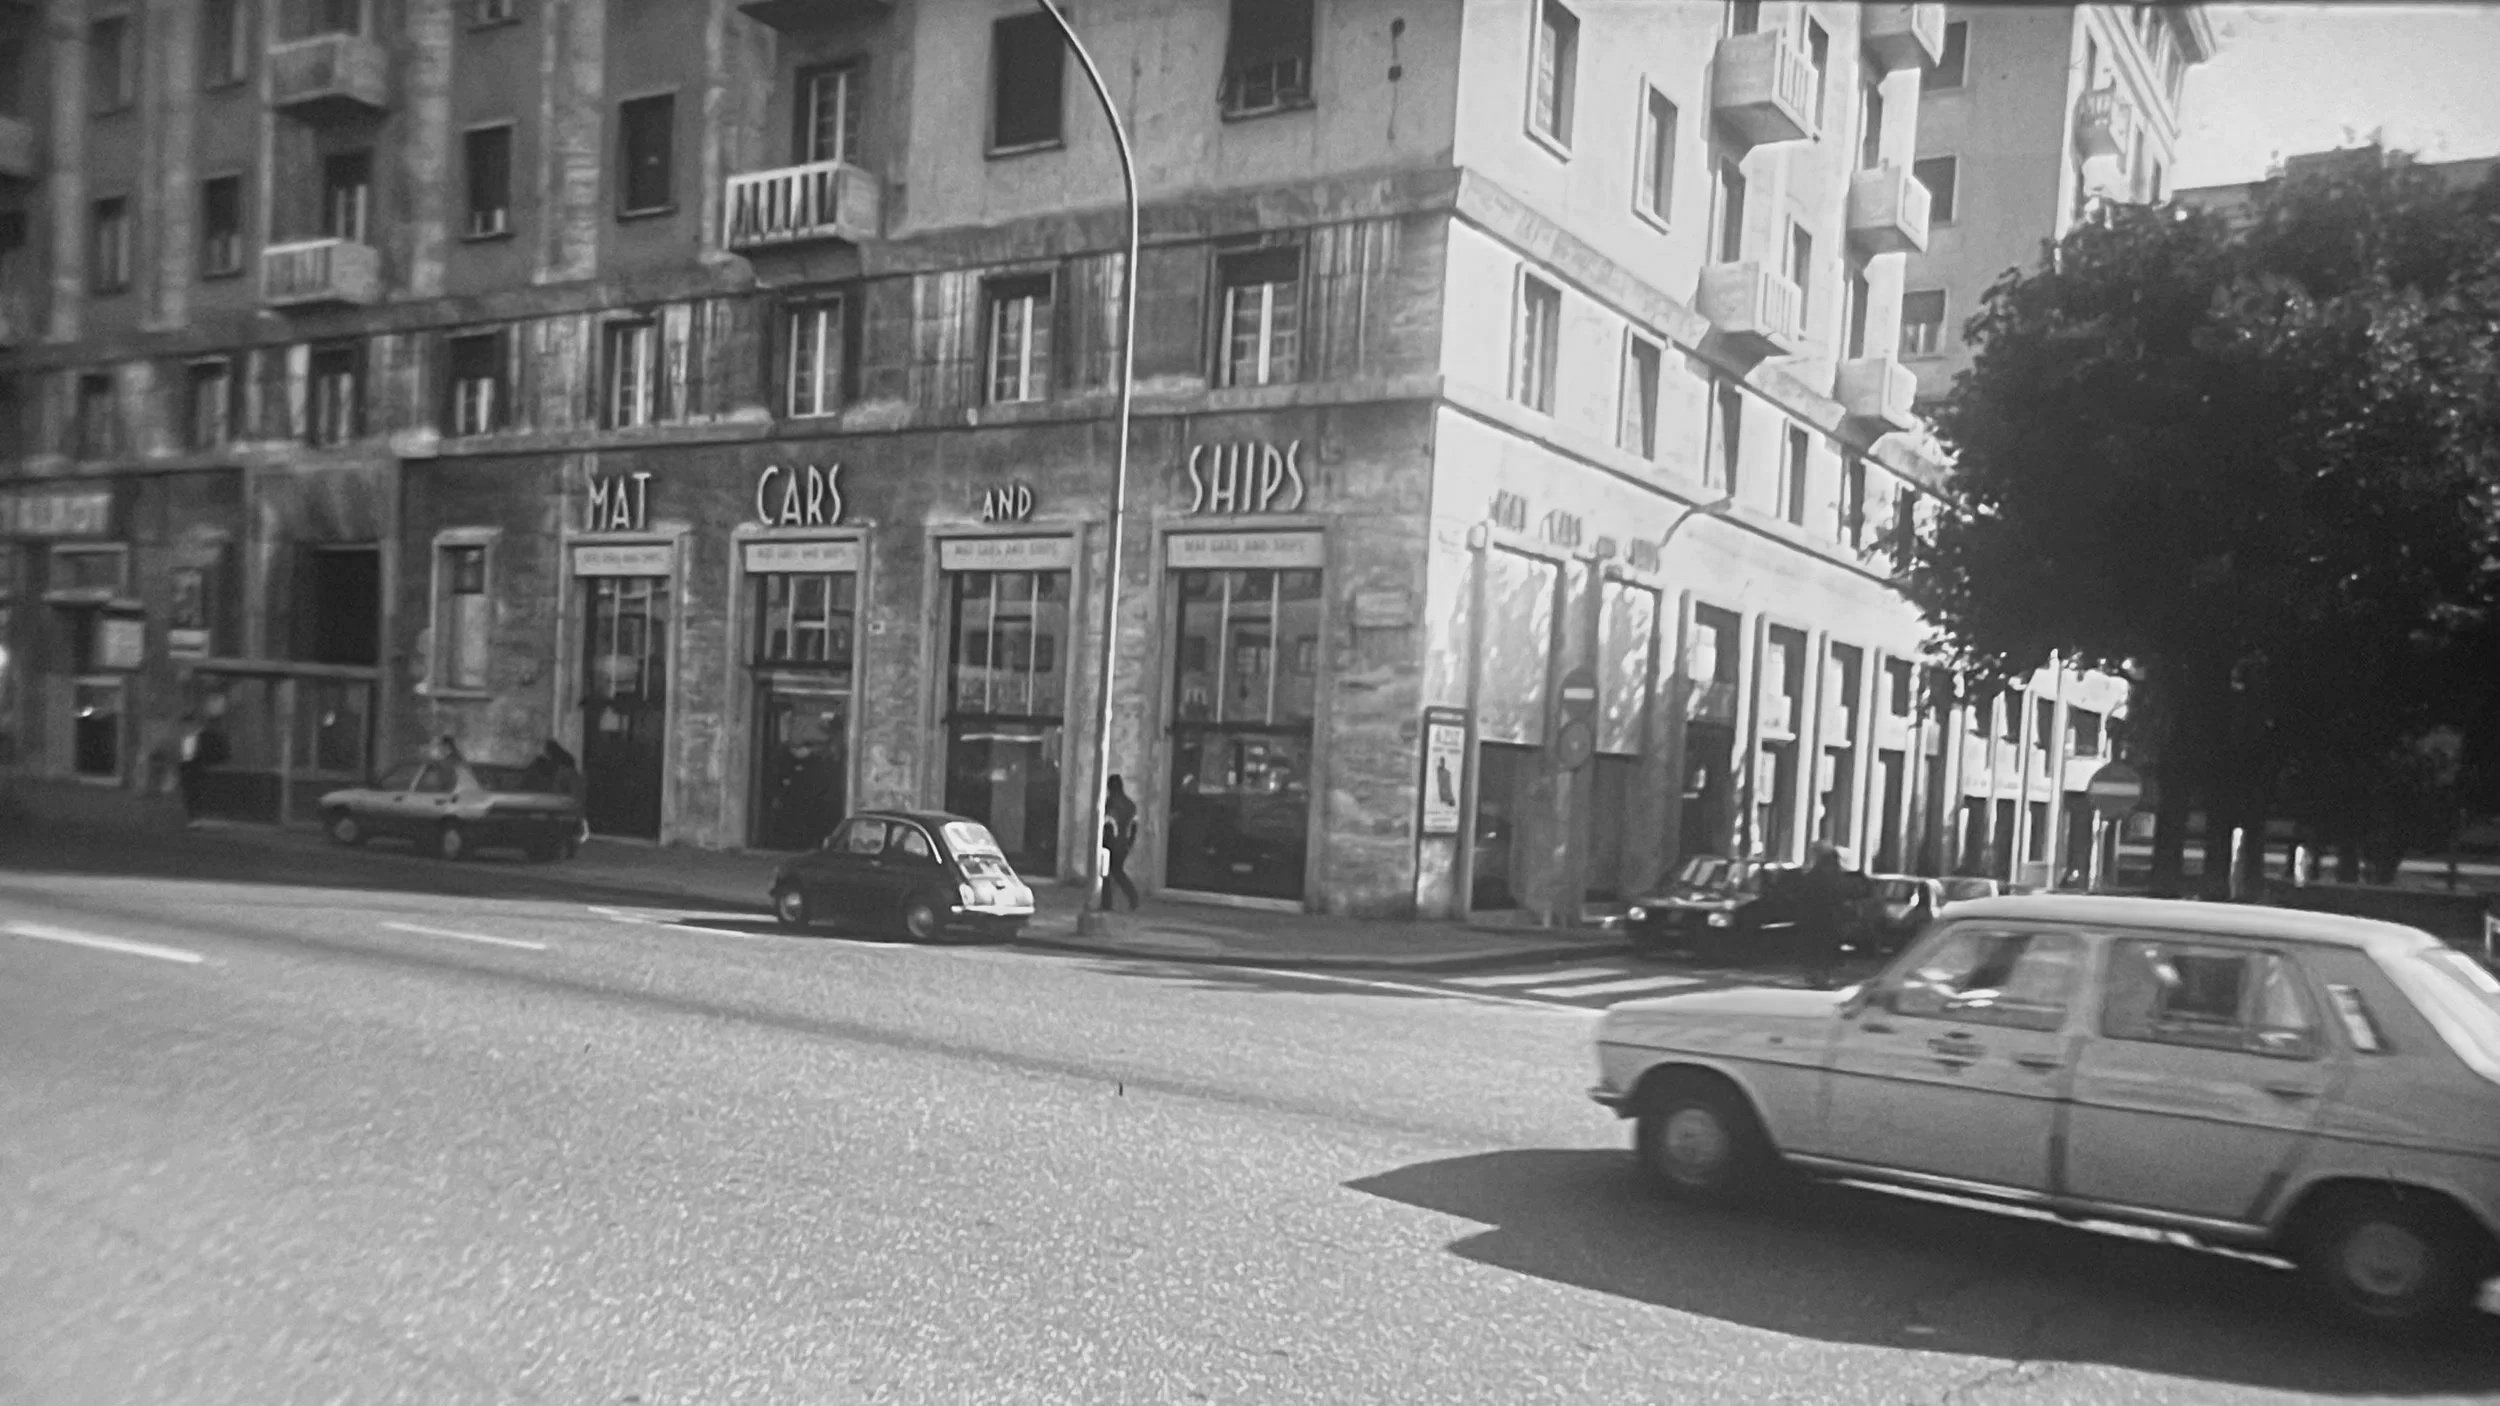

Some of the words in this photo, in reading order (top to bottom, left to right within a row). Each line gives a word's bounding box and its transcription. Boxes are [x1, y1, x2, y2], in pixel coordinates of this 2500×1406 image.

[586, 472, 651, 530] MAT
[756, 463, 841, 525] CARS
[982, 484, 1033, 521] AND
[1188, 439, 1304, 512] SHIPS
